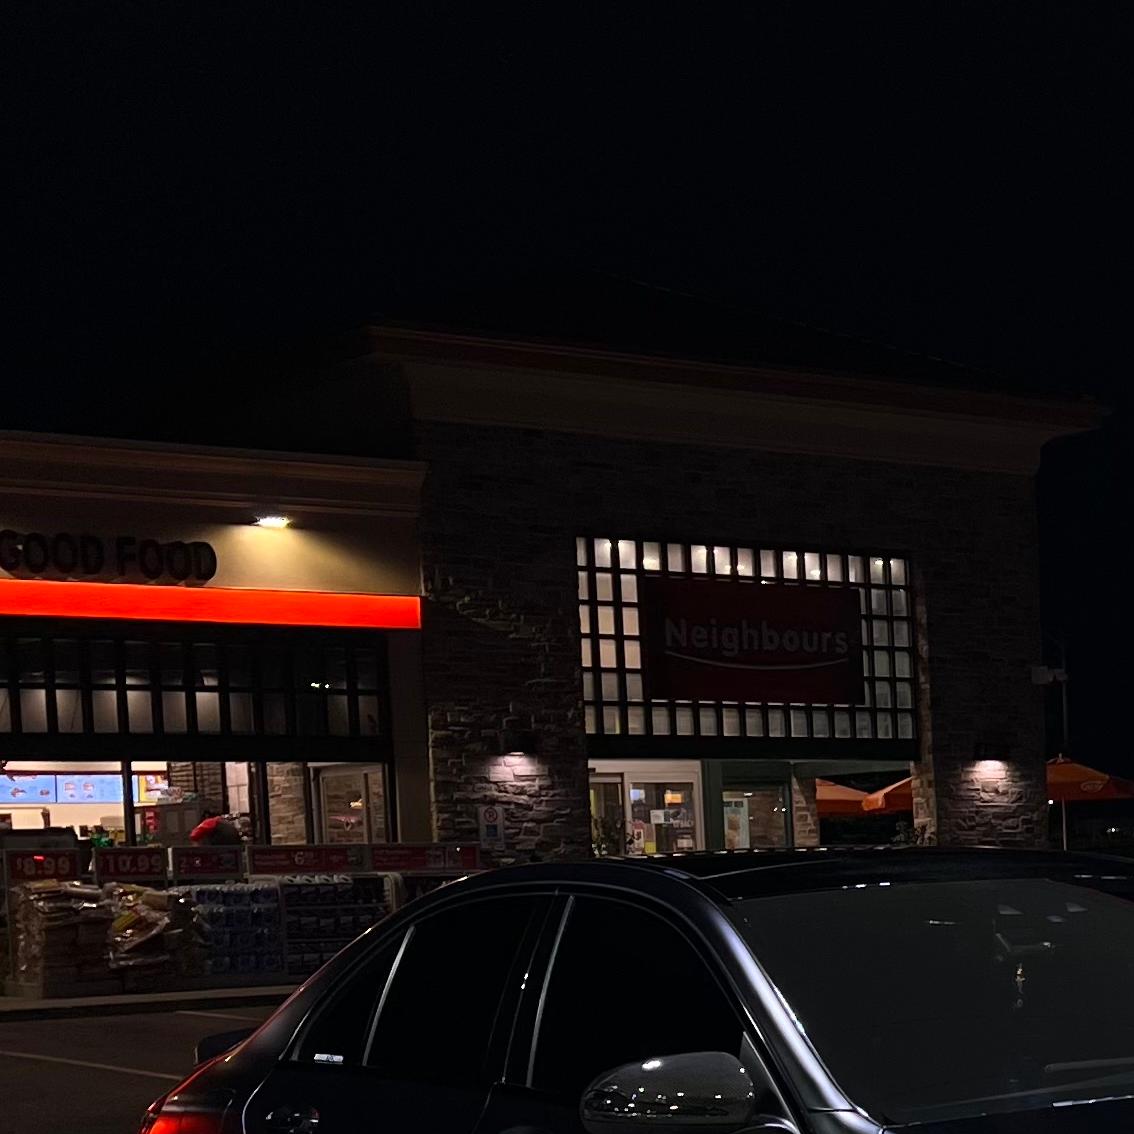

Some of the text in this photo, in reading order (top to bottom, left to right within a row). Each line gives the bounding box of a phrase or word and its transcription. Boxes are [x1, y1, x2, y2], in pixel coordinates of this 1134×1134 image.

[0, 530, 217, 581] GOOD FOOD
[664, 616, 850, 658] Neighbours
